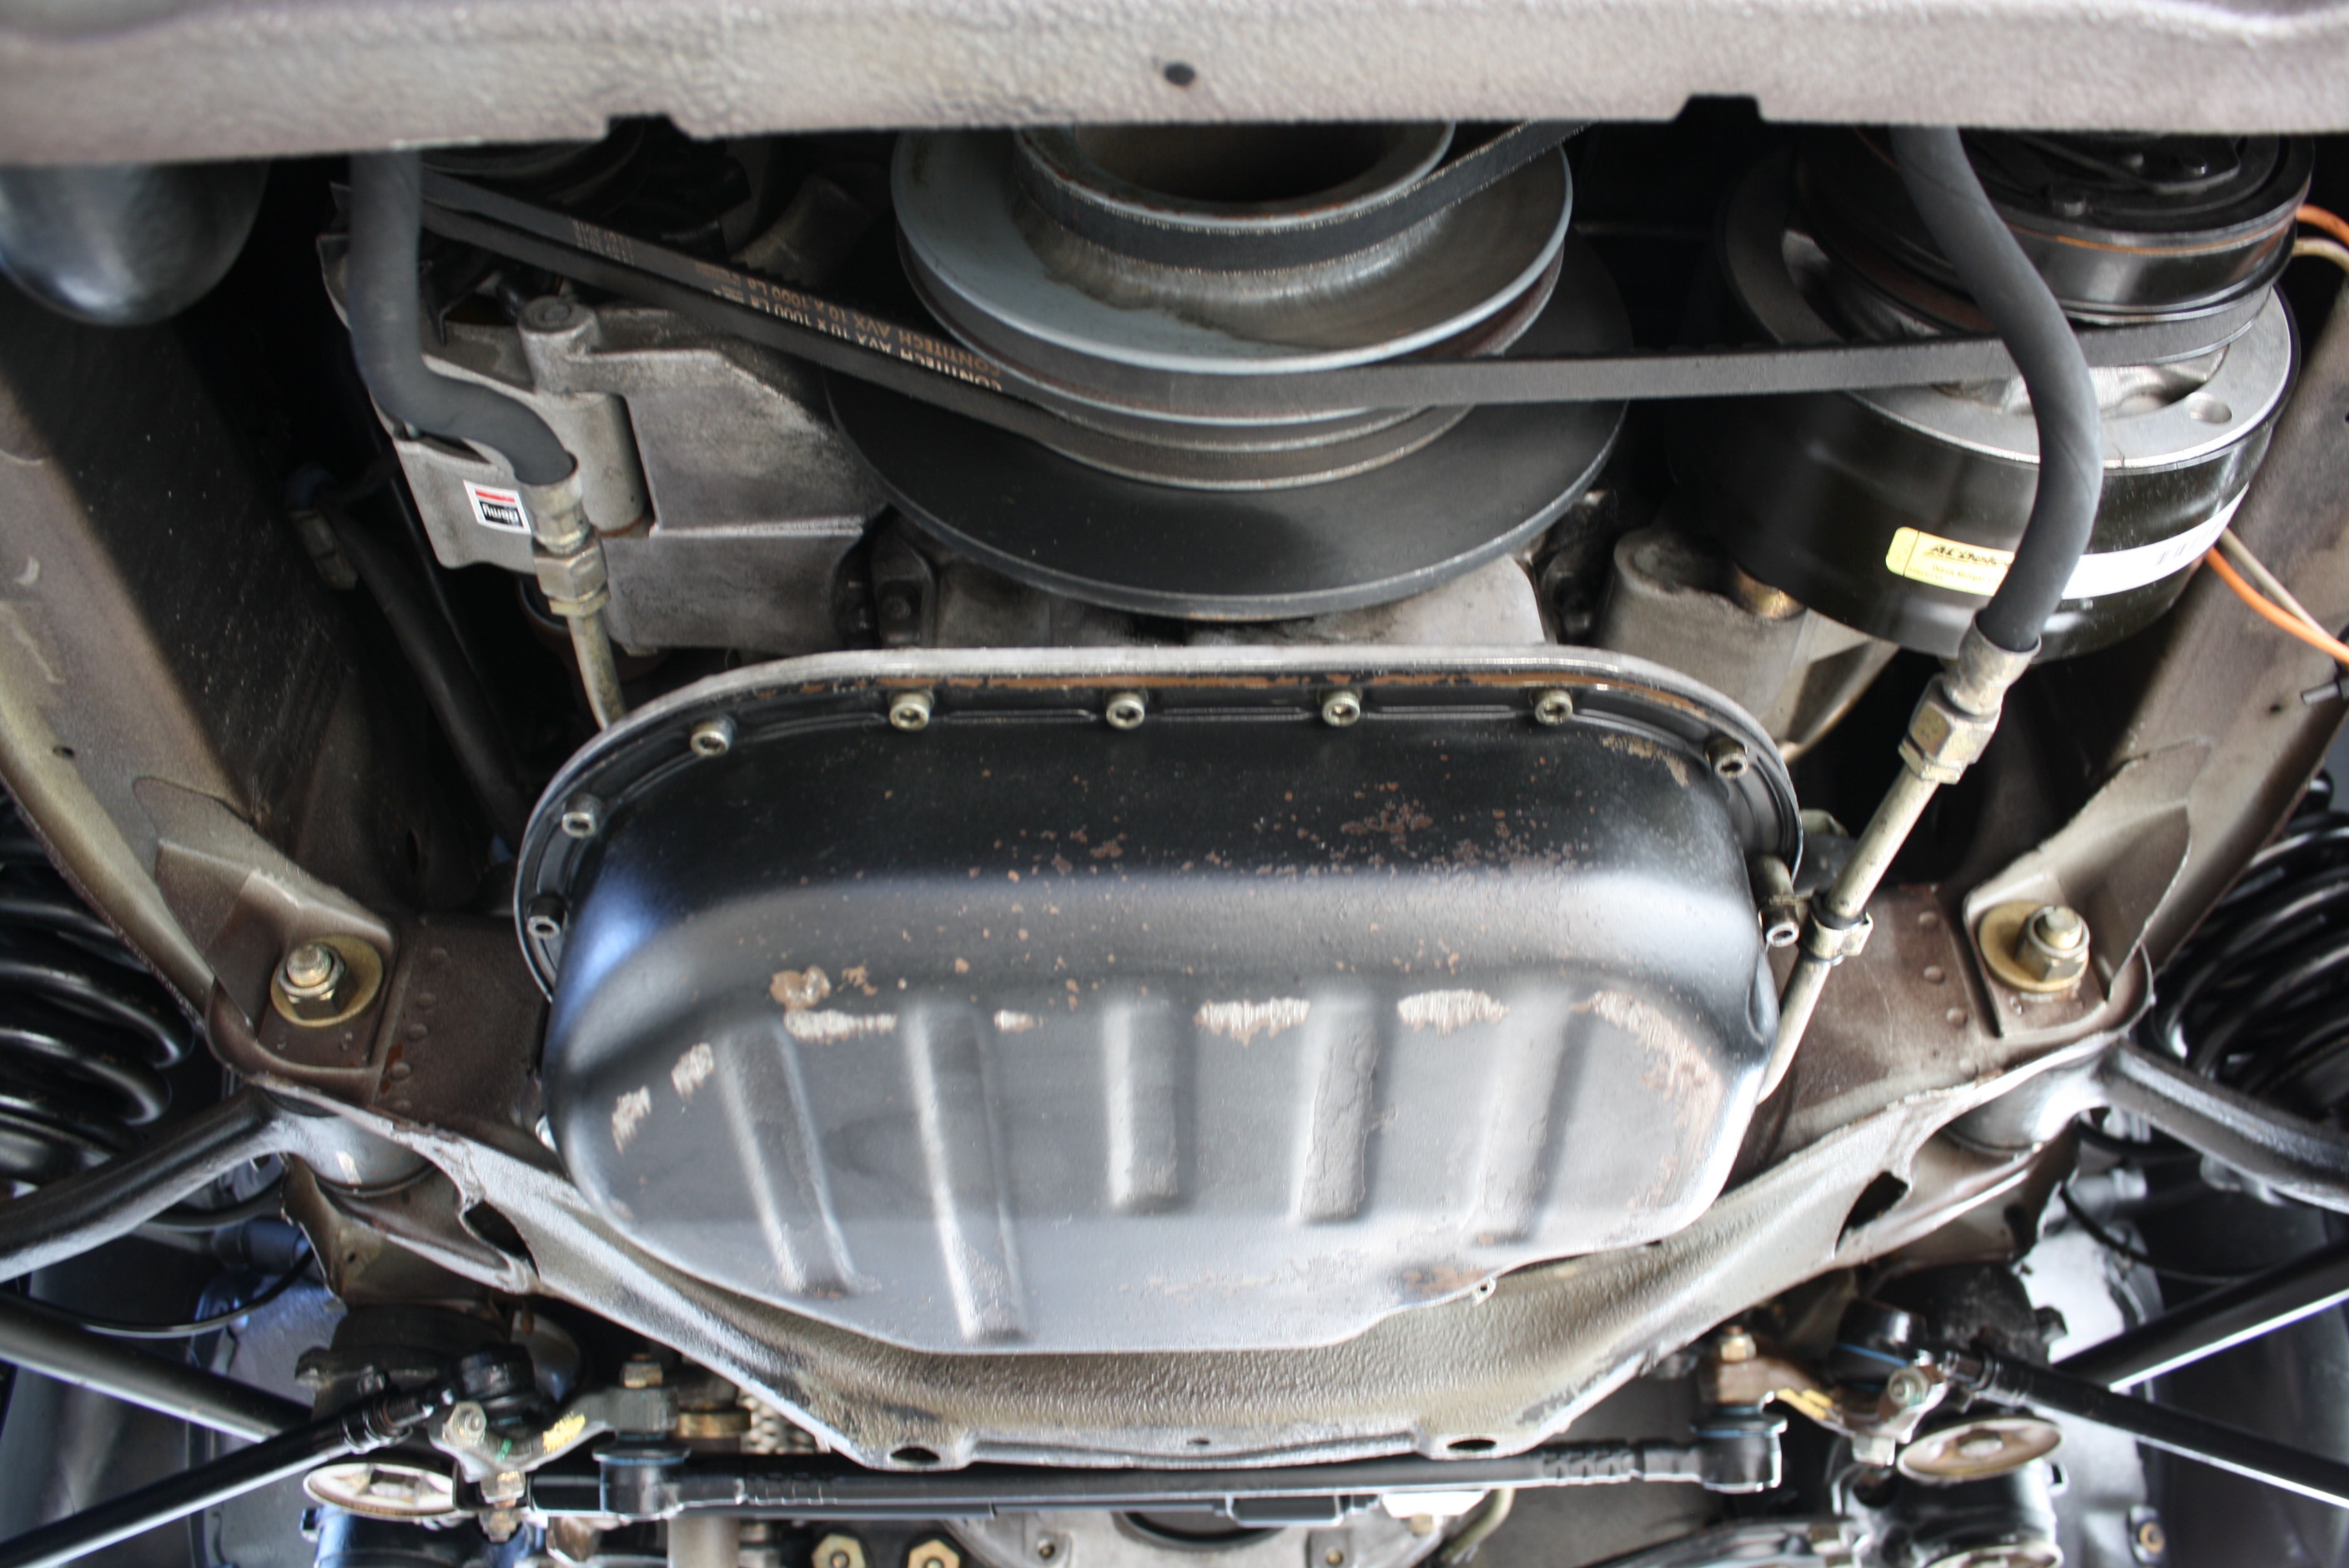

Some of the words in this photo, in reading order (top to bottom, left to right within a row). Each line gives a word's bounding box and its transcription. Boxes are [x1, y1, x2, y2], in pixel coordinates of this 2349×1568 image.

[772, 285, 807, 309] 1000
[854, 314, 890, 338] AVX
[899, 329, 1001, 376] CONTITECH
